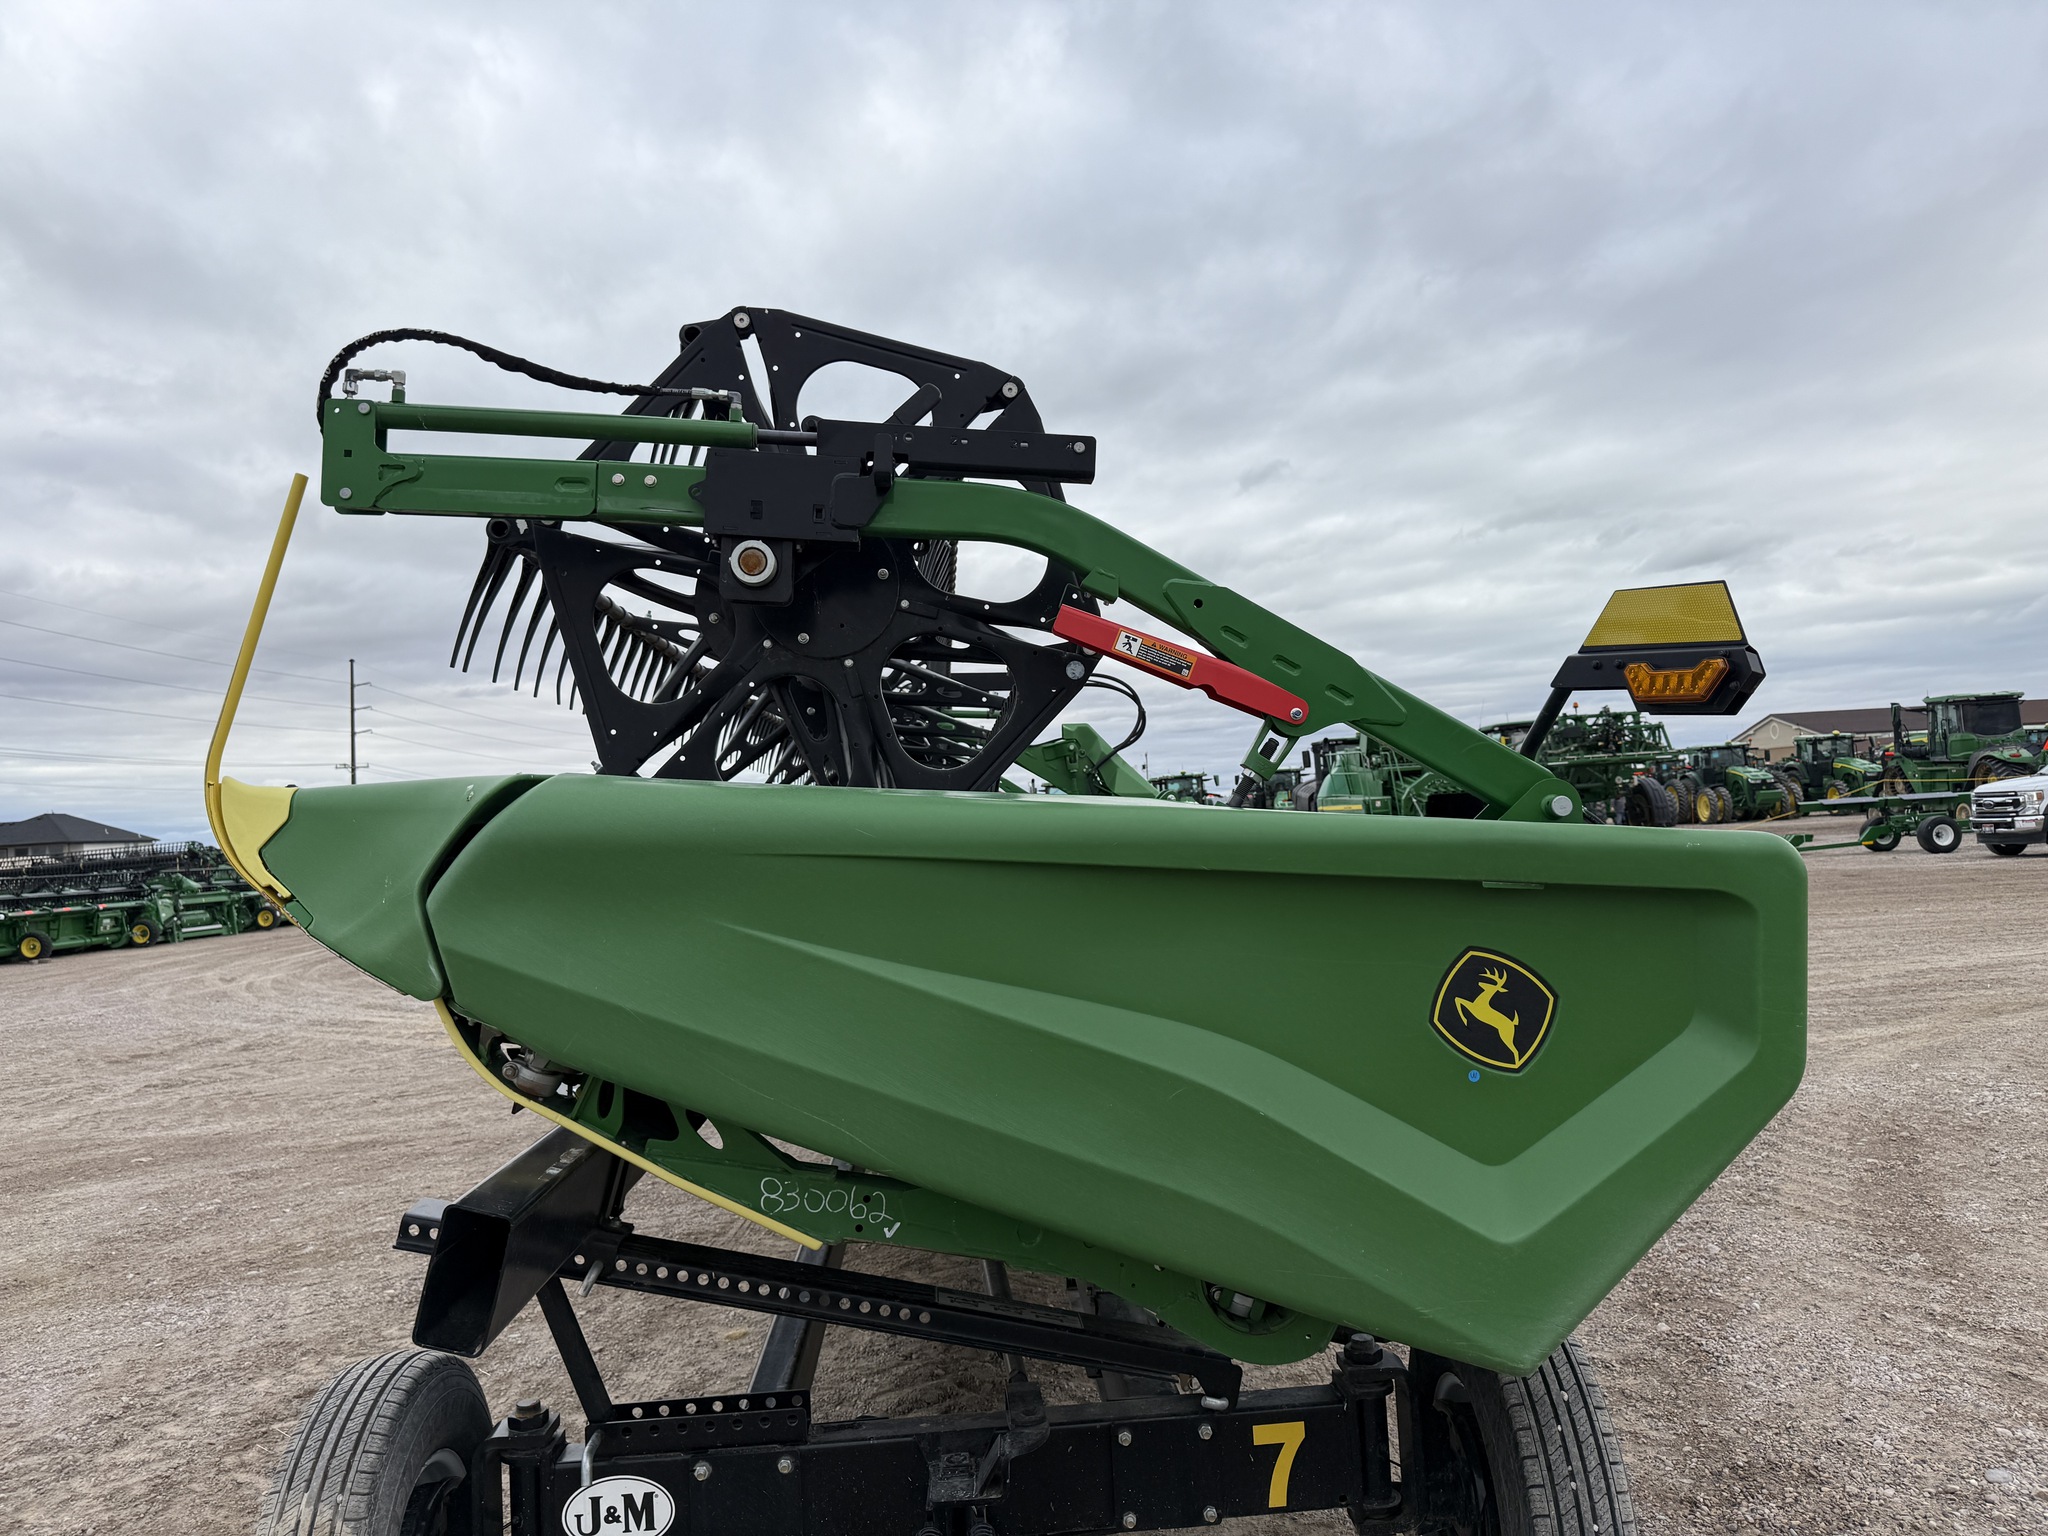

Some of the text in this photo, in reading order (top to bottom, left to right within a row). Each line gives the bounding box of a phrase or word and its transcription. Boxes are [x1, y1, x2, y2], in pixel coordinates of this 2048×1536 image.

[1159, 643, 1188, 659] WARNING
[760, 1176, 894, 1224] 830062
[1252, 1420, 1306, 1508] 7
[574, 1491, 657, 1536] J&M
